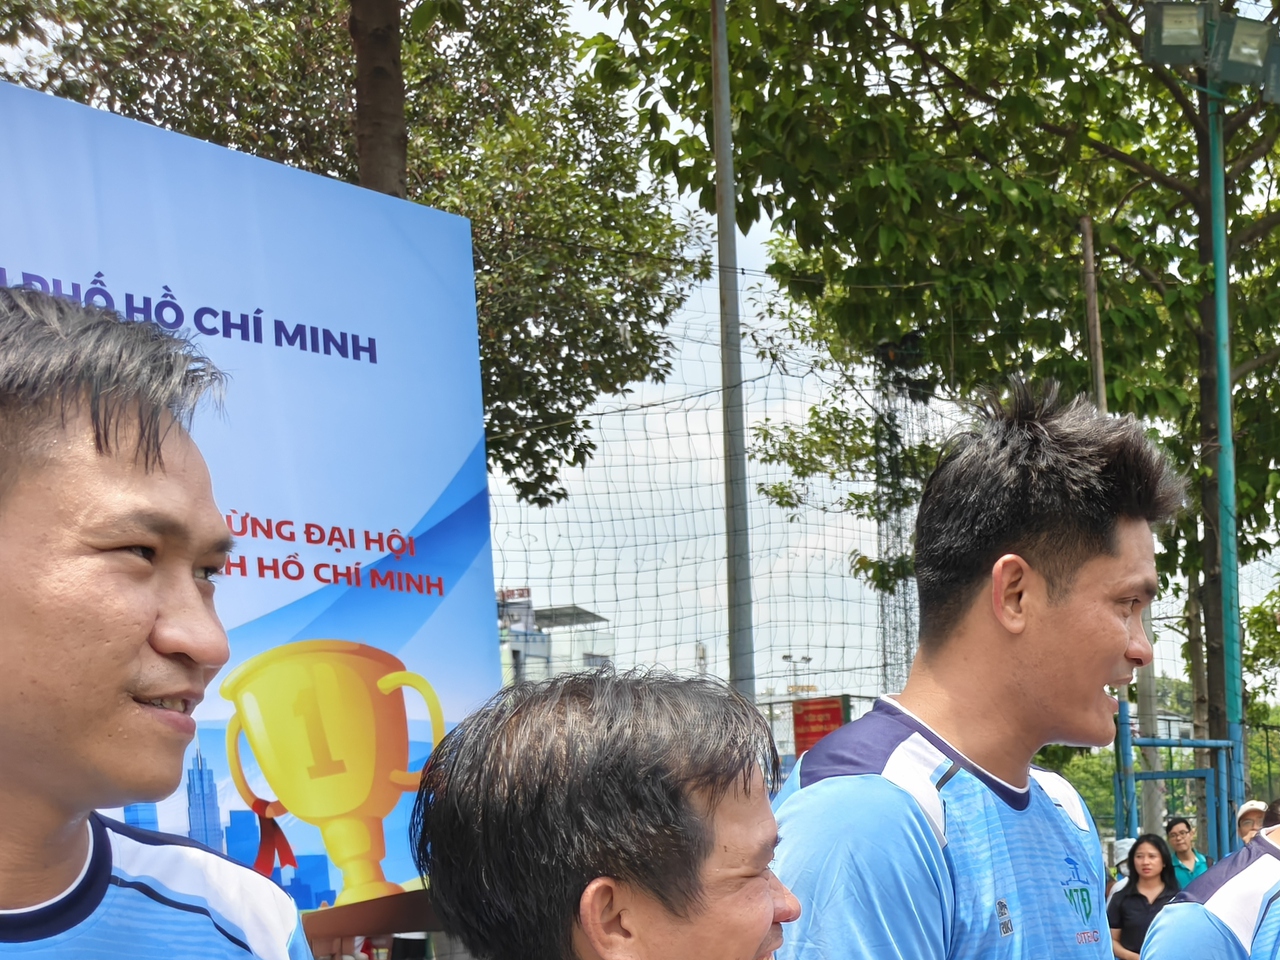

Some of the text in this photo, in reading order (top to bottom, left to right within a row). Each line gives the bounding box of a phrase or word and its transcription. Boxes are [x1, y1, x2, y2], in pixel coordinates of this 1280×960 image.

[125, 285, 185, 330] HỒ
[194, 307, 264, 344] CHÍ
[274, 319, 378, 364] MINH
[225, 509, 416, 560] ỪNG ĐẠI HỘI
[257, 552, 305, 581] HỒ
[313, 562, 362, 587] CHÍ
[370, 568, 444, 596] MINH
